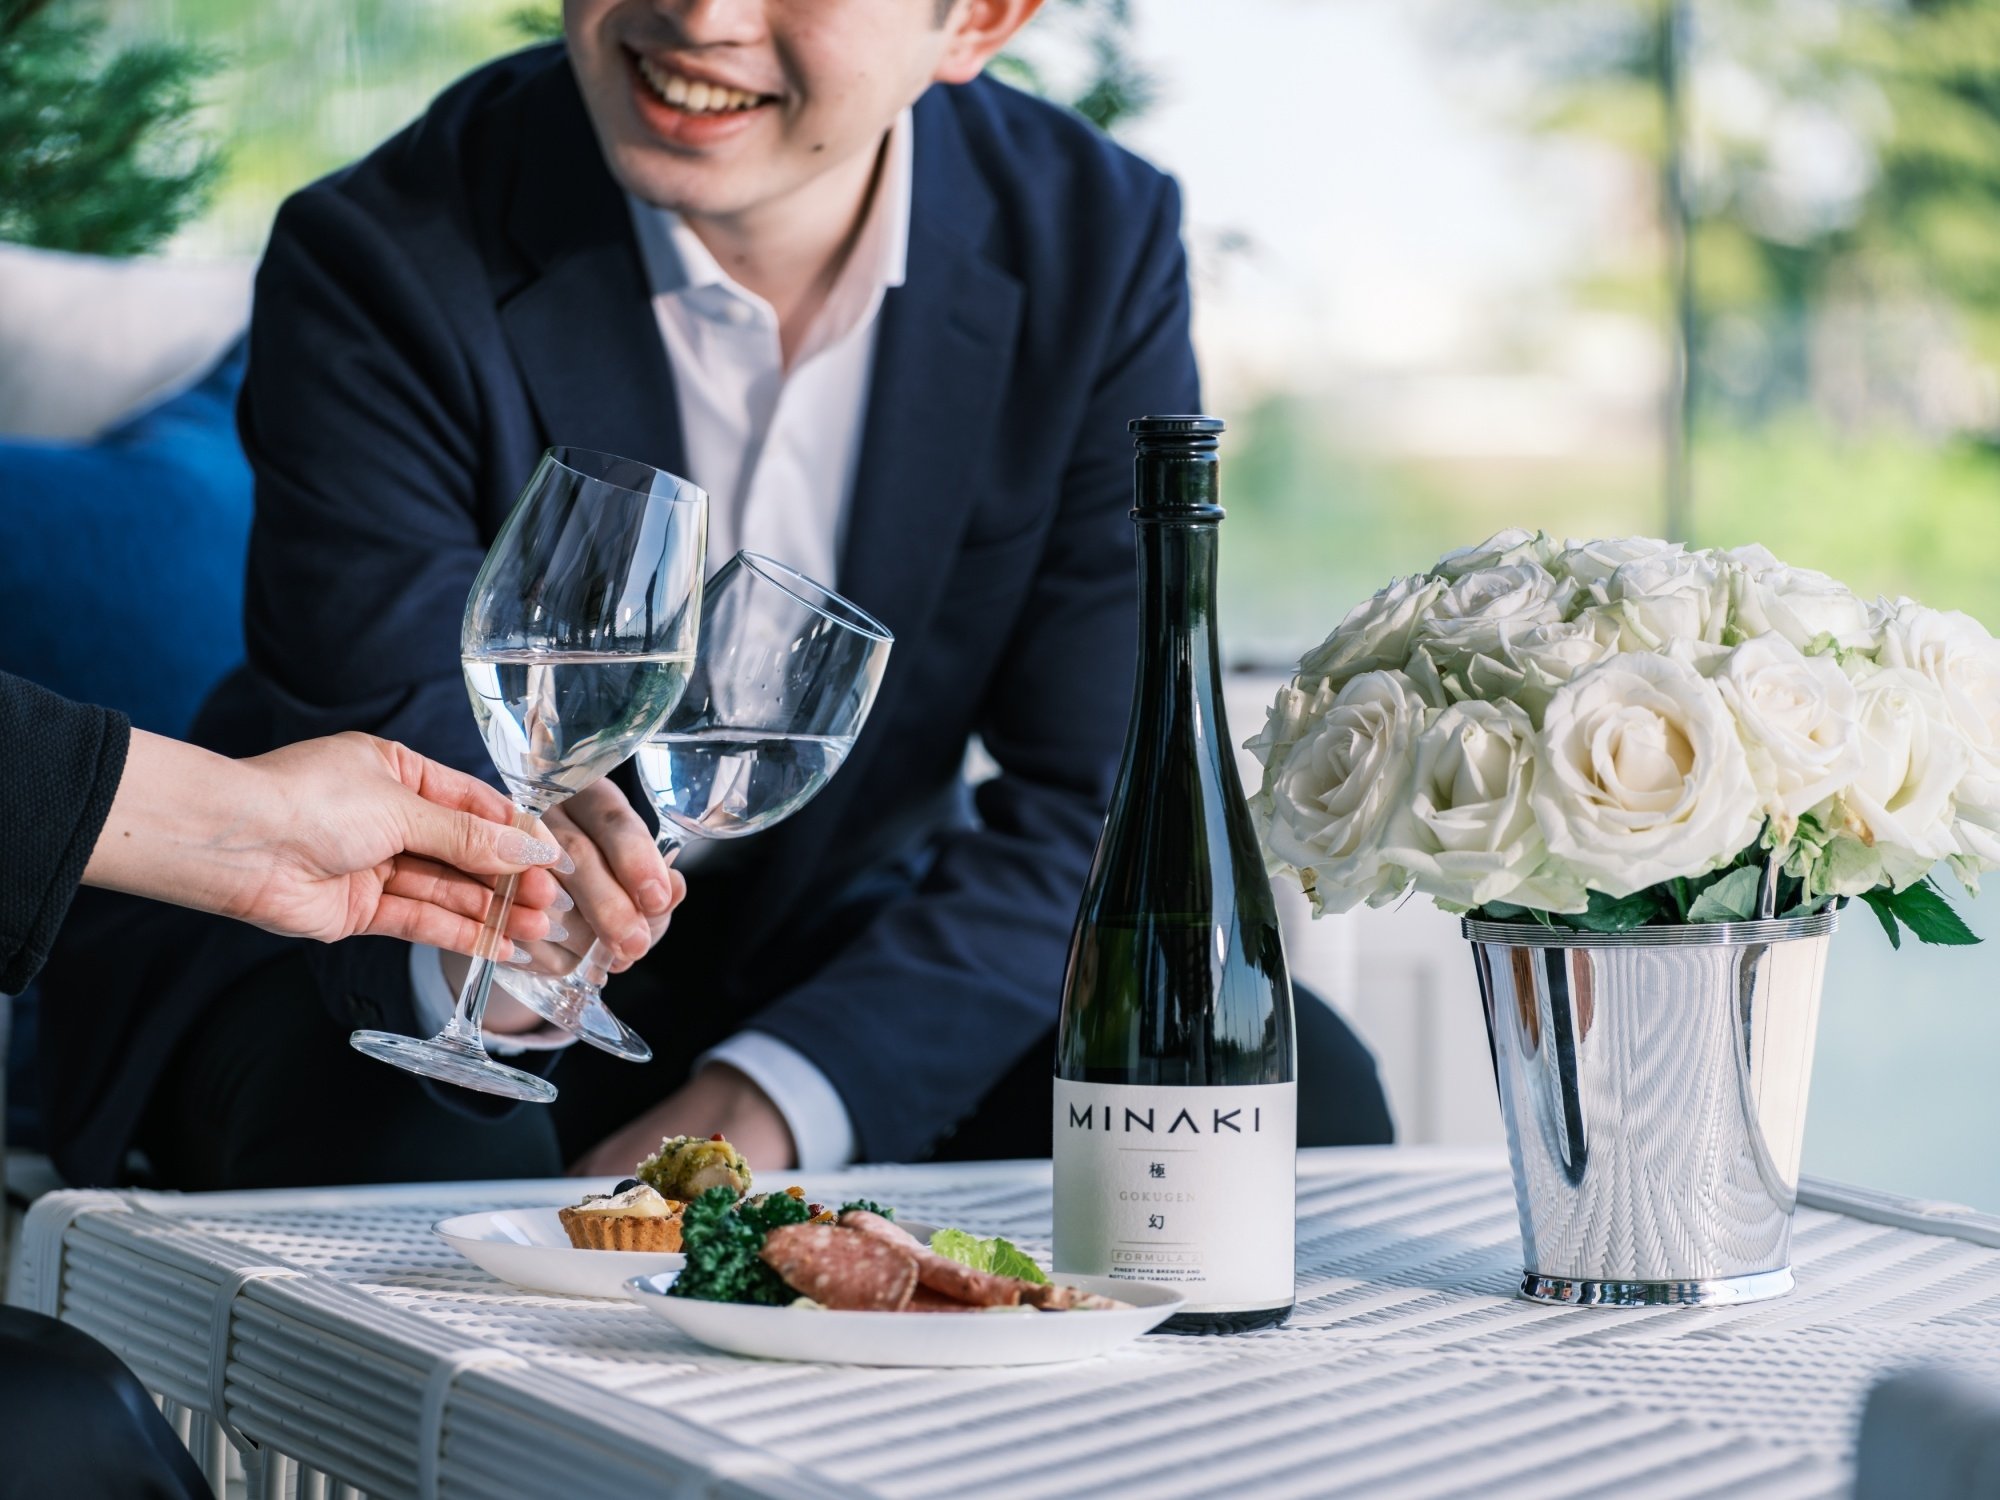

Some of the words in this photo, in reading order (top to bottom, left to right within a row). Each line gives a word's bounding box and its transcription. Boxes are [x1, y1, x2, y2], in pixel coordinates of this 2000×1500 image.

[1069, 1102, 1260, 1133] MINAKI
[1148, 1162, 1166, 1179] 極
[1119, 1190, 1196, 1202] GOKUGEN
[1148, 1213, 1165, 1230] 幻
[1116, 1252, 1184, 1262] FORMULA
